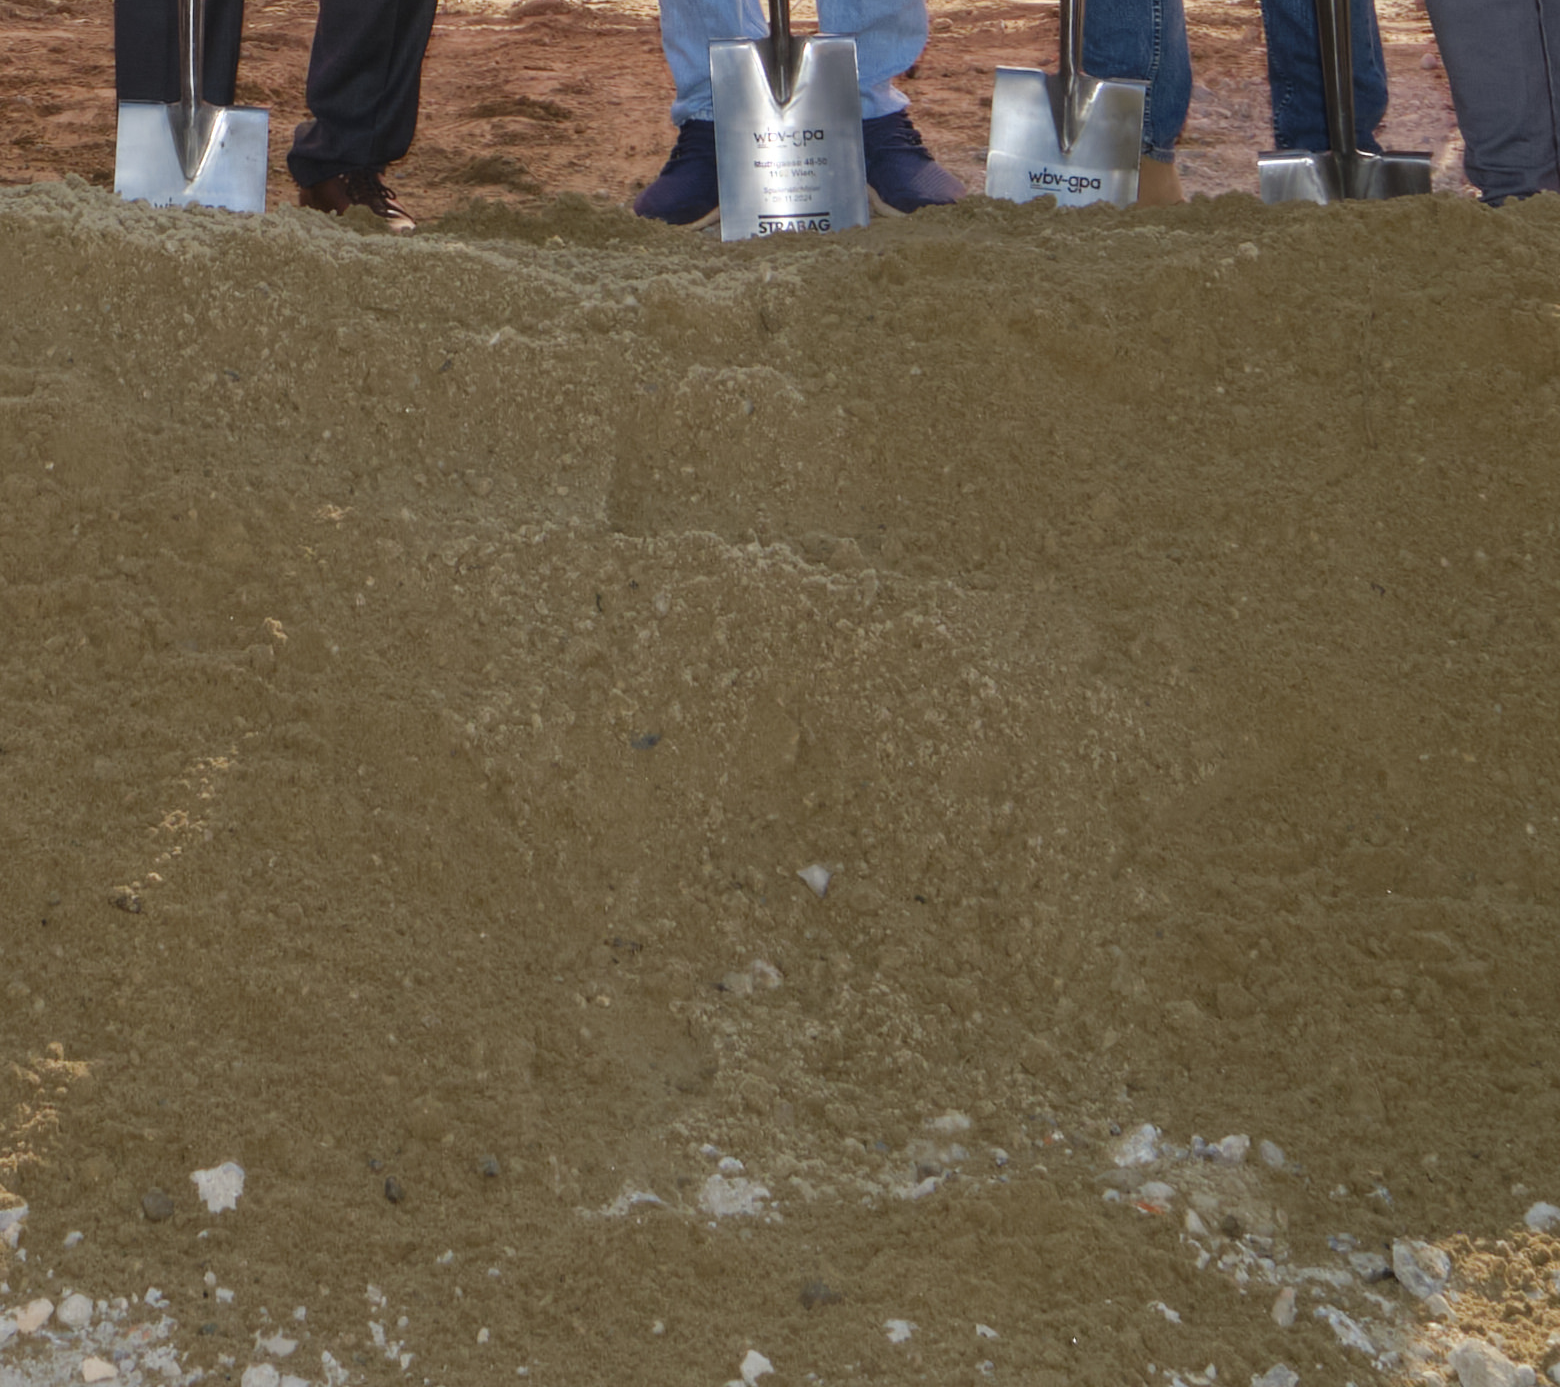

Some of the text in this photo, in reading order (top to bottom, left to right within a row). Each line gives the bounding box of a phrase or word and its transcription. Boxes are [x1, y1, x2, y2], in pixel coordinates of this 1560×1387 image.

[753, 127, 824, 147] wbv-gpa
[1028, 167, 1102, 193] wbv-gpa
[758, 218, 831, 234] STRABAG
